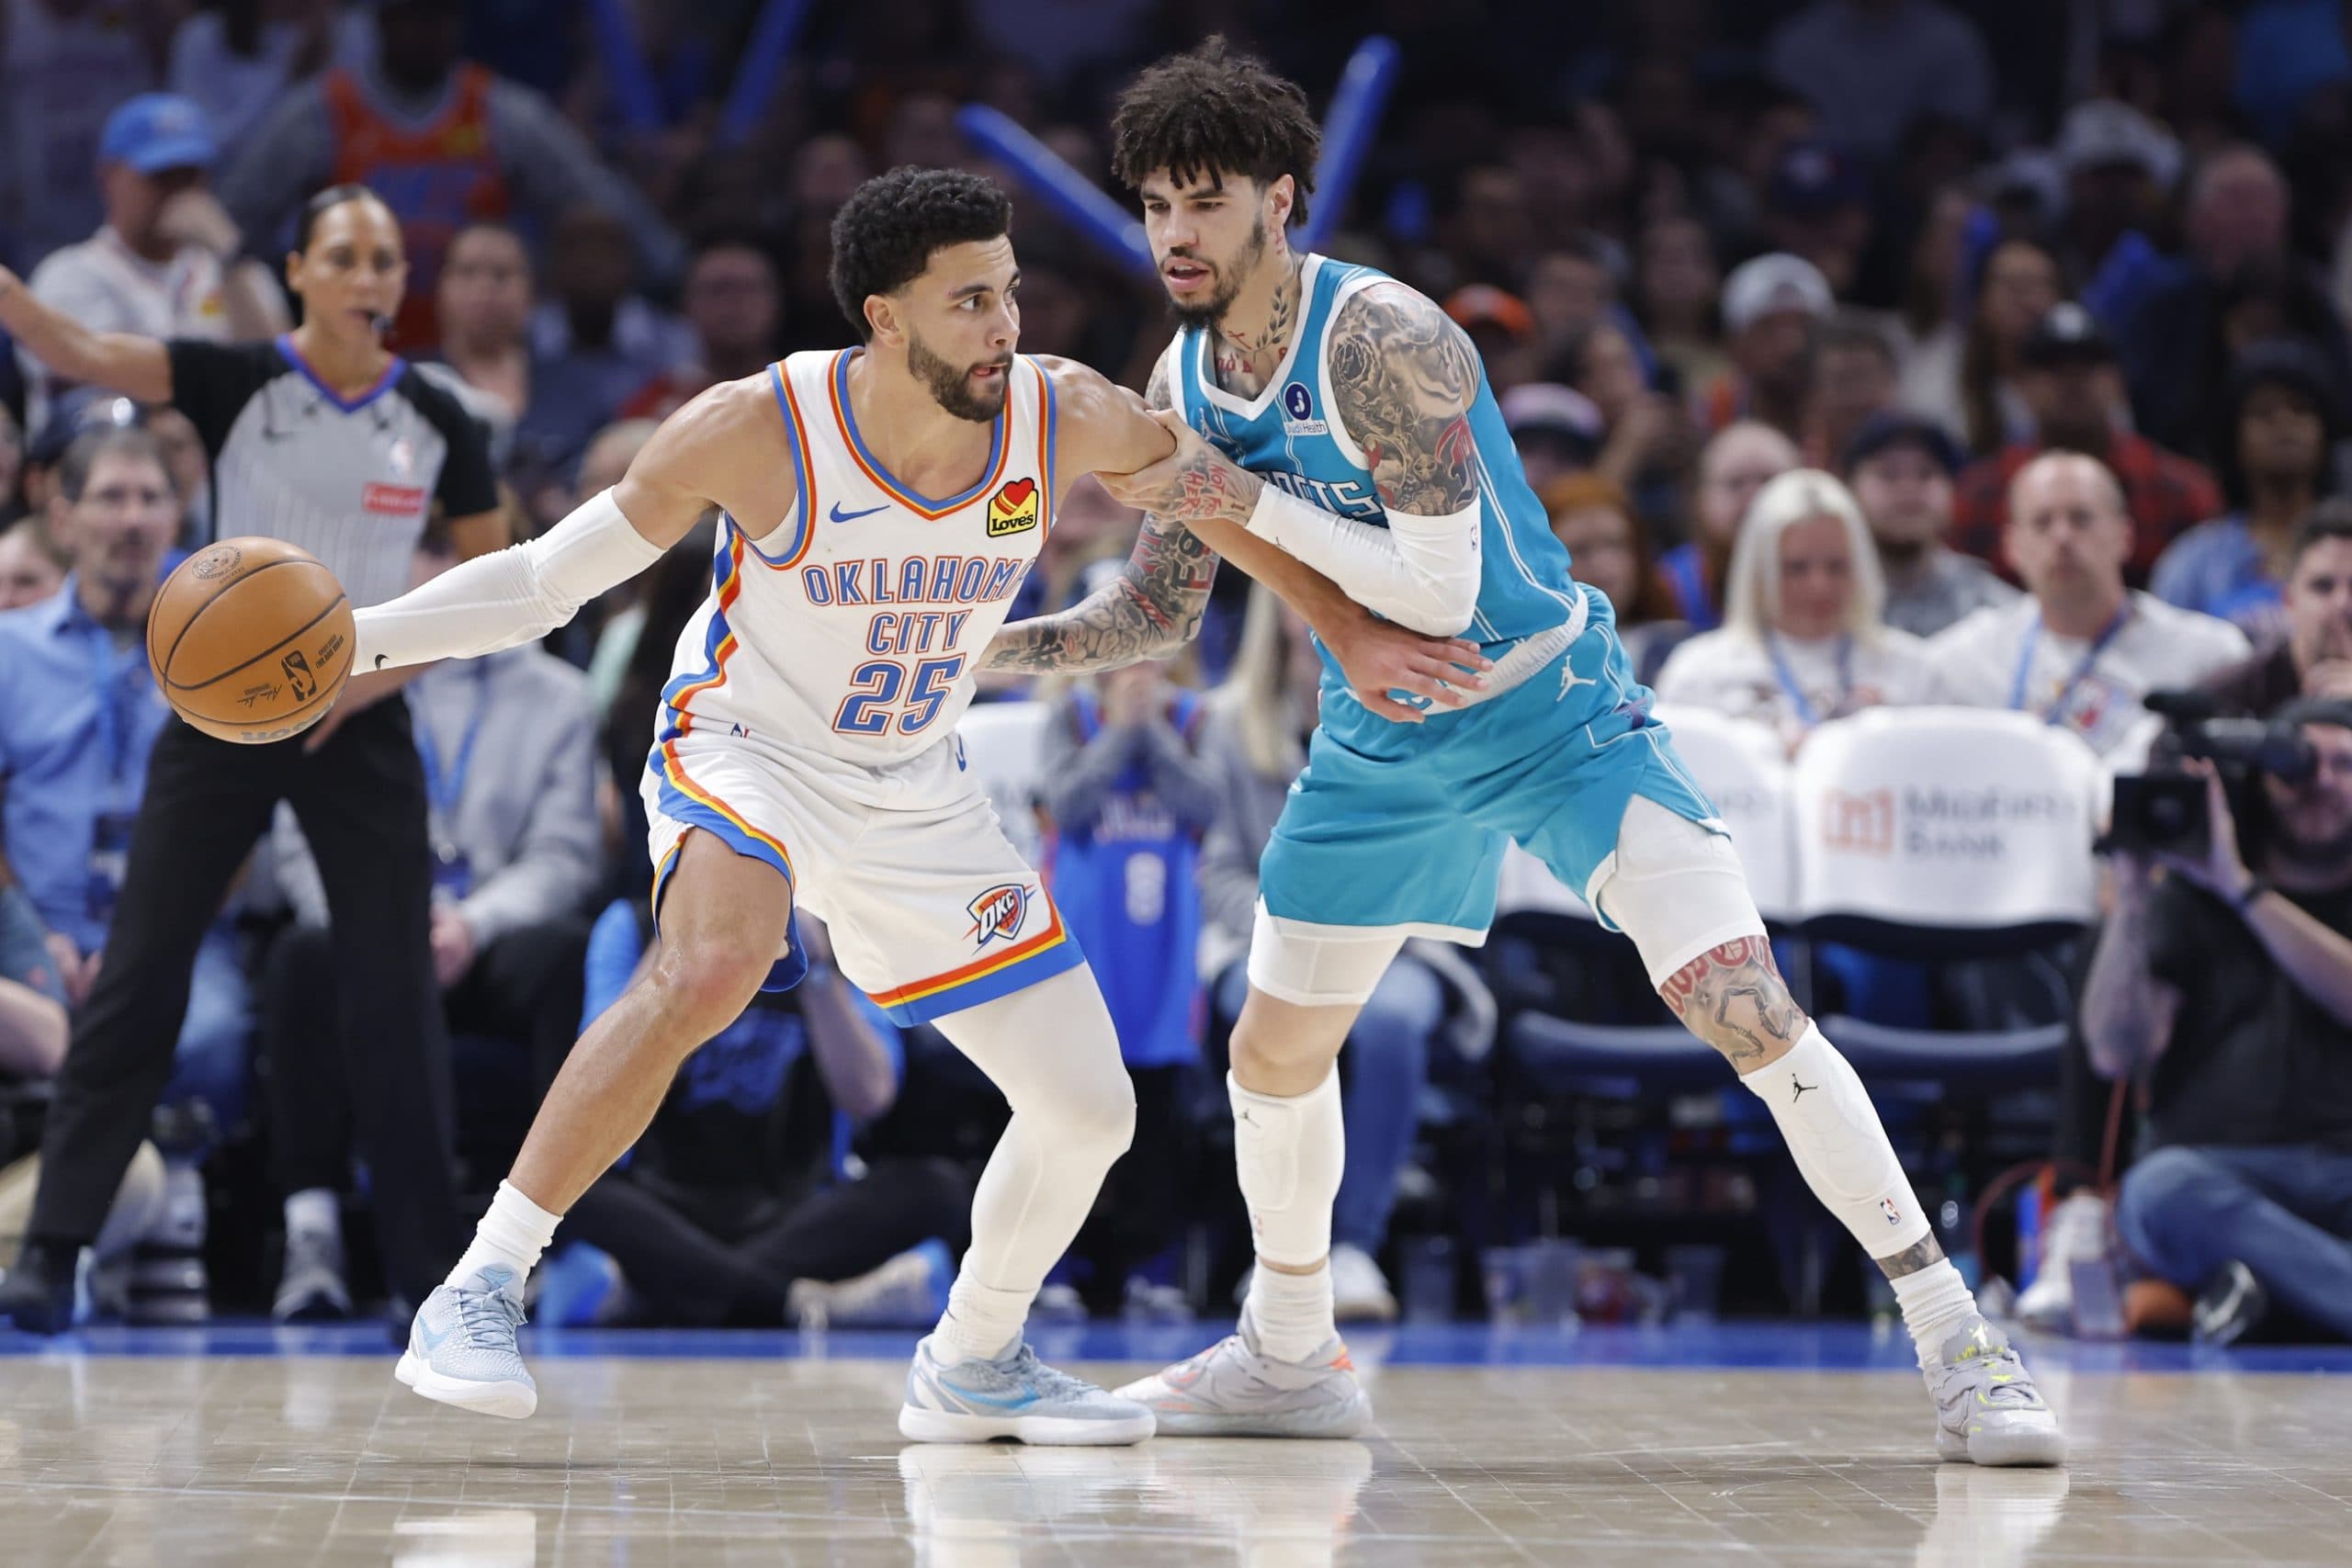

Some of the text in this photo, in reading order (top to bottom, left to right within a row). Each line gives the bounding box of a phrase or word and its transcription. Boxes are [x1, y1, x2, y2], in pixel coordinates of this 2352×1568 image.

[1303, 421, 1327, 434] Health
[991, 510, 1035, 532] Love's
[866, 608, 974, 656] CITY
[831, 652, 967, 737] 25
[978, 889, 1015, 944] OKC
